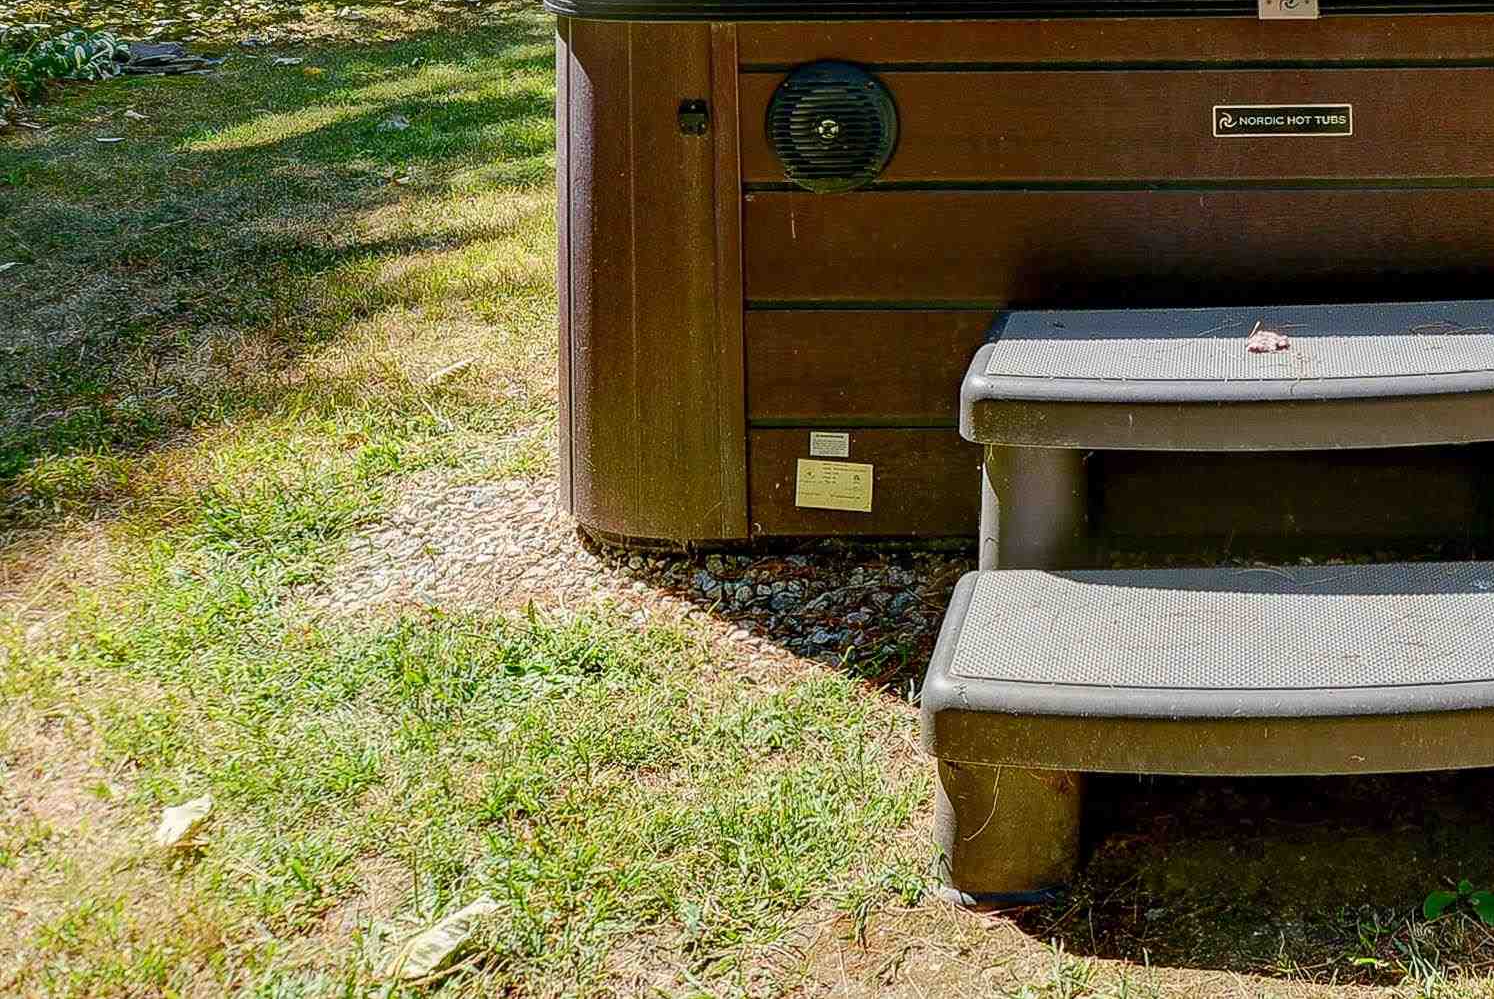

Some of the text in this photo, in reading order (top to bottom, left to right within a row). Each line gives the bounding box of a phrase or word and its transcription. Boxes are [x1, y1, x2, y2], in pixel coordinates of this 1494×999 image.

[1239, 115, 1347, 126] NORDIC HOT TUBS
